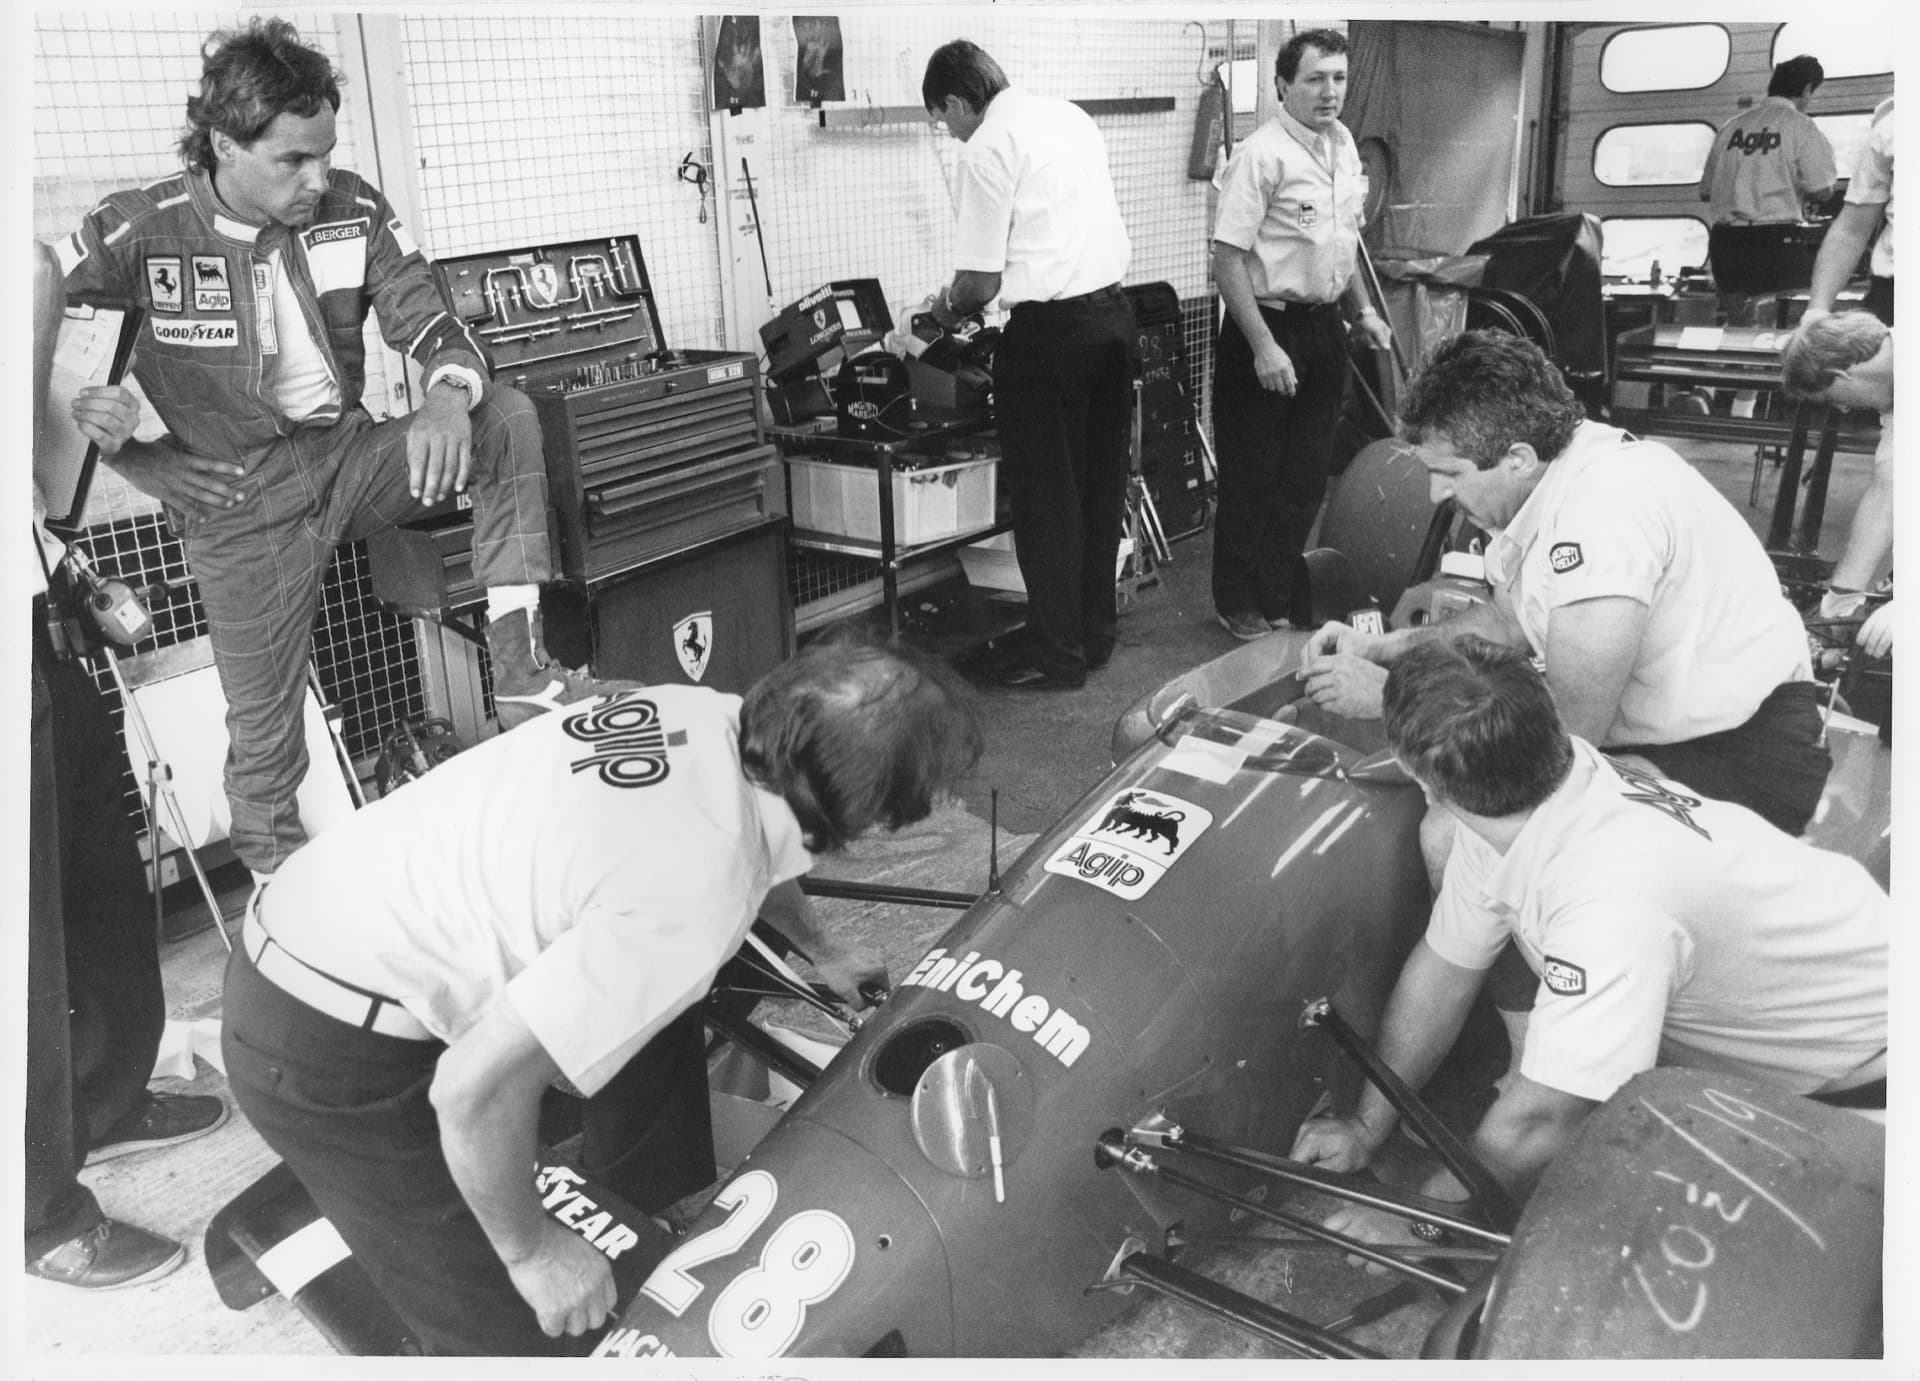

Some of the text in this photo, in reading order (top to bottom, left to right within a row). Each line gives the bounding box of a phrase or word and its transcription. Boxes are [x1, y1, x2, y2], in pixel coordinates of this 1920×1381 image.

[1727, 127, 1781, 156] Agip
[315, 226, 361, 243] BERGER
[198, 293, 230, 309] Agip
[798, 284, 833, 313] olivetti
[1056, 841, 1145, 887] Agip
[900, 948, 1091, 1068] EniChem
[640, 1169, 856, 1358] 28
